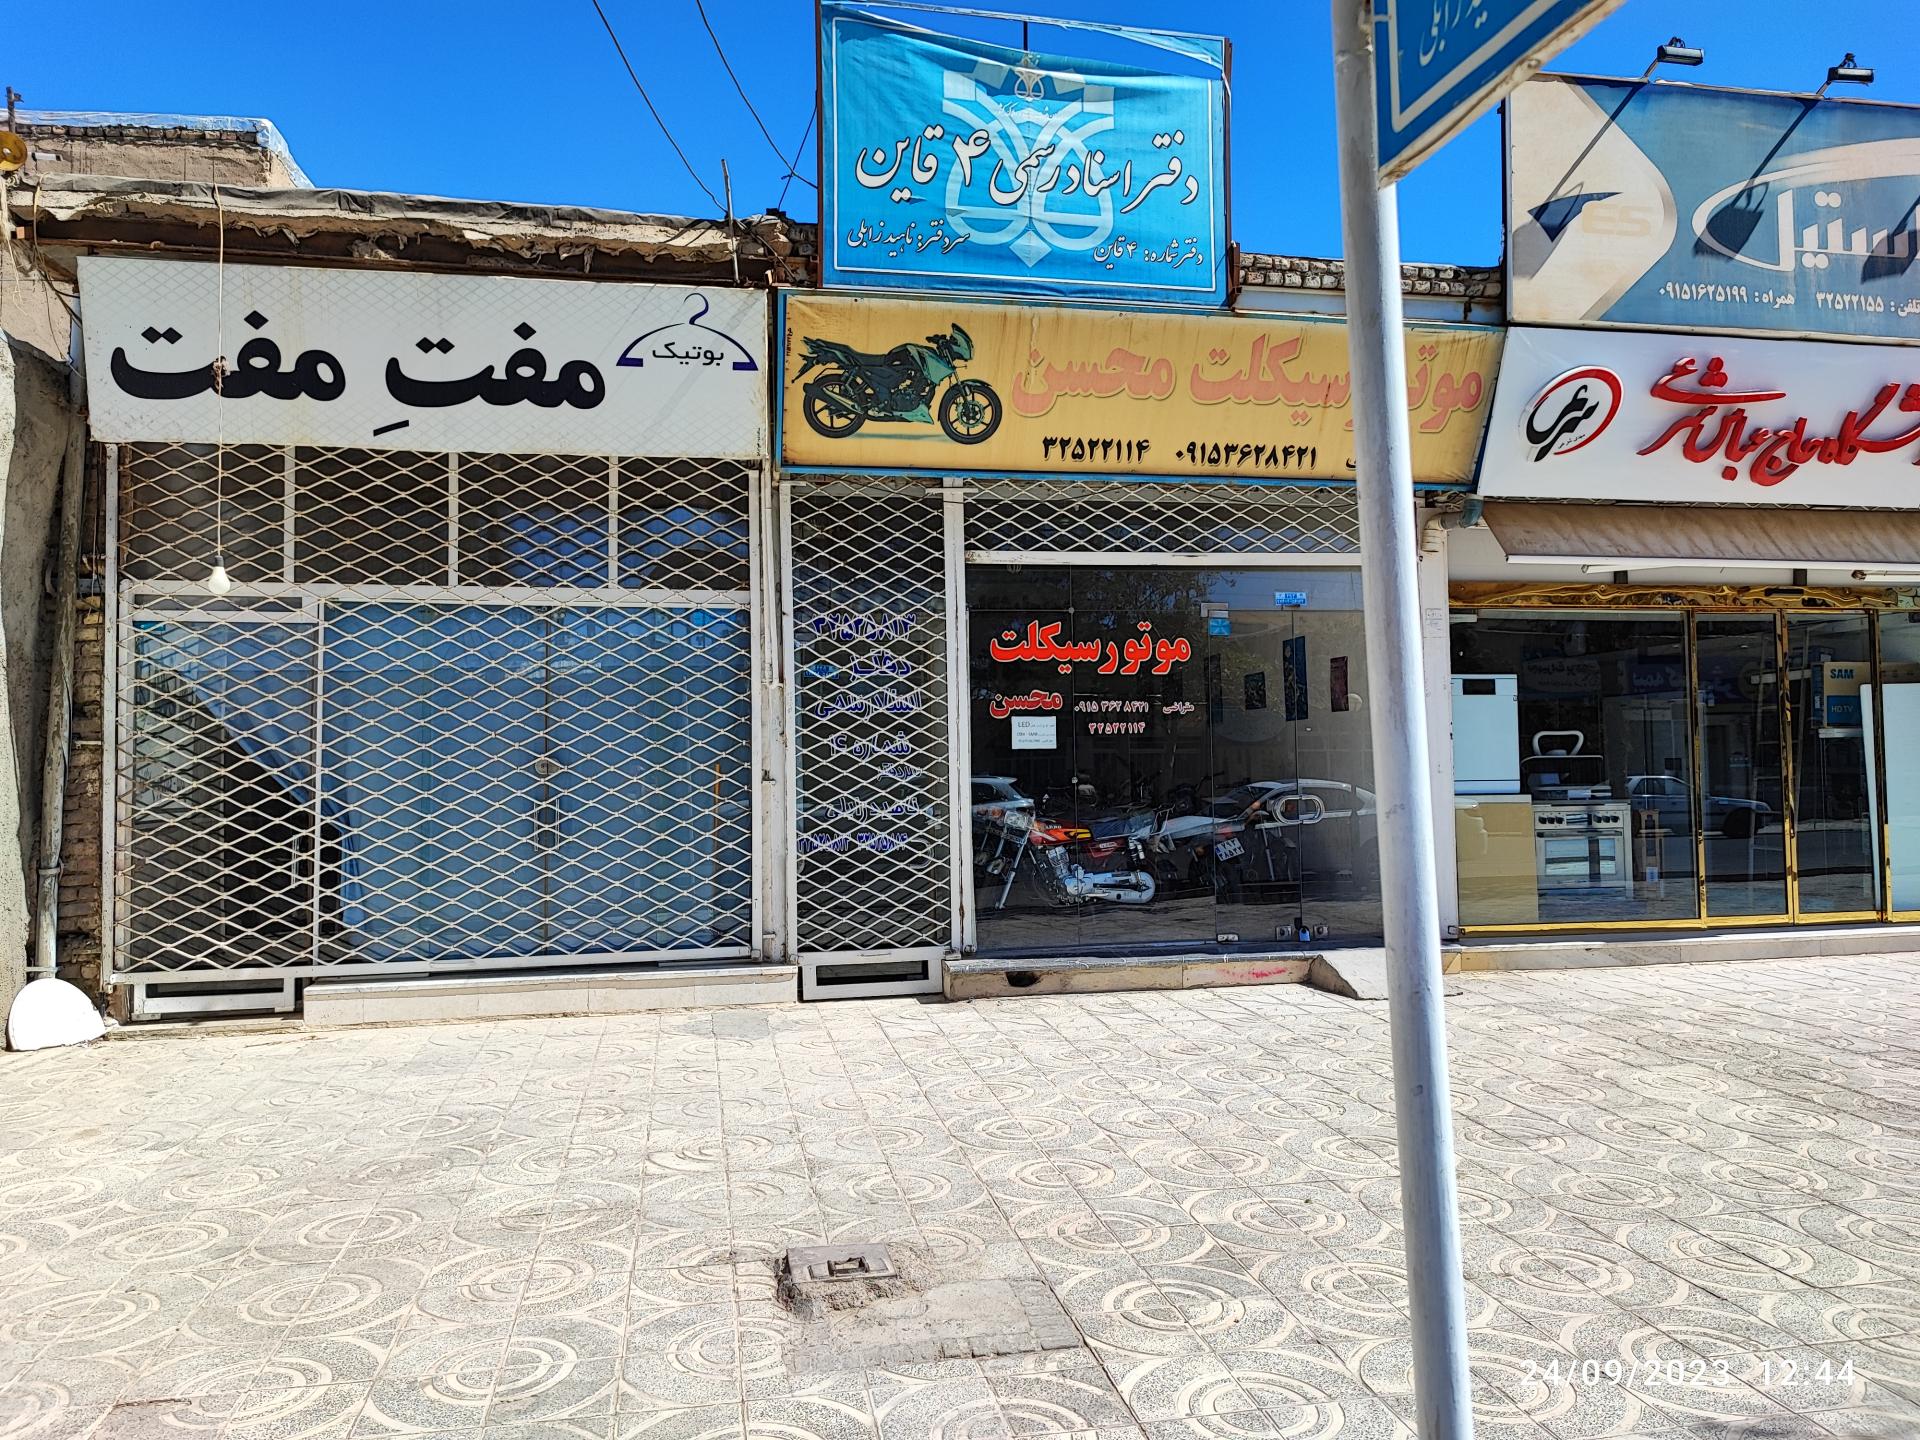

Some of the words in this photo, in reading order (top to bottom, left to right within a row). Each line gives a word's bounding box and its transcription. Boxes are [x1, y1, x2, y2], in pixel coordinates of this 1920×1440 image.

[855, 122, 944, 203] قاین
[952, 128, 992, 187] ۴
[987, 140, 1061, 206] رسمی
[1062, 149, 1132, 199] اسناد
[1121, 129, 1199, 213] دفتر
[882, 221, 916, 258] ناهید
[1093, 235, 1126, 270] قاین
[1125, 240, 1138, 258] ۴
[1172, 236, 1203, 268] دفتر
[1658, 280, 1749, 304] ۰۹۱۵۱۶۲۵۱۹۹
[1815, 290, 1885, 313] ۳۲۵۲۲۱۵۵
[111, 310, 347, 403] مفت
[651, 340, 726, 367] بوتیک
[1011, 340, 1176, 417] محسن
[1042, 435, 1151, 464] ۳۲۵۲۲۱۱۴
[1175, 440, 1318, 469] ۰۹۱۵۳۶۲۸۴۲۱
[988, 619, 1192, 675] موتورسیکلت
[1830, 668, 1855, 679] SAM
[988, 686, 1064, 719] محسن
[1088, 721, 1146, 735] ۳۲۵۲۲۱۱۴
